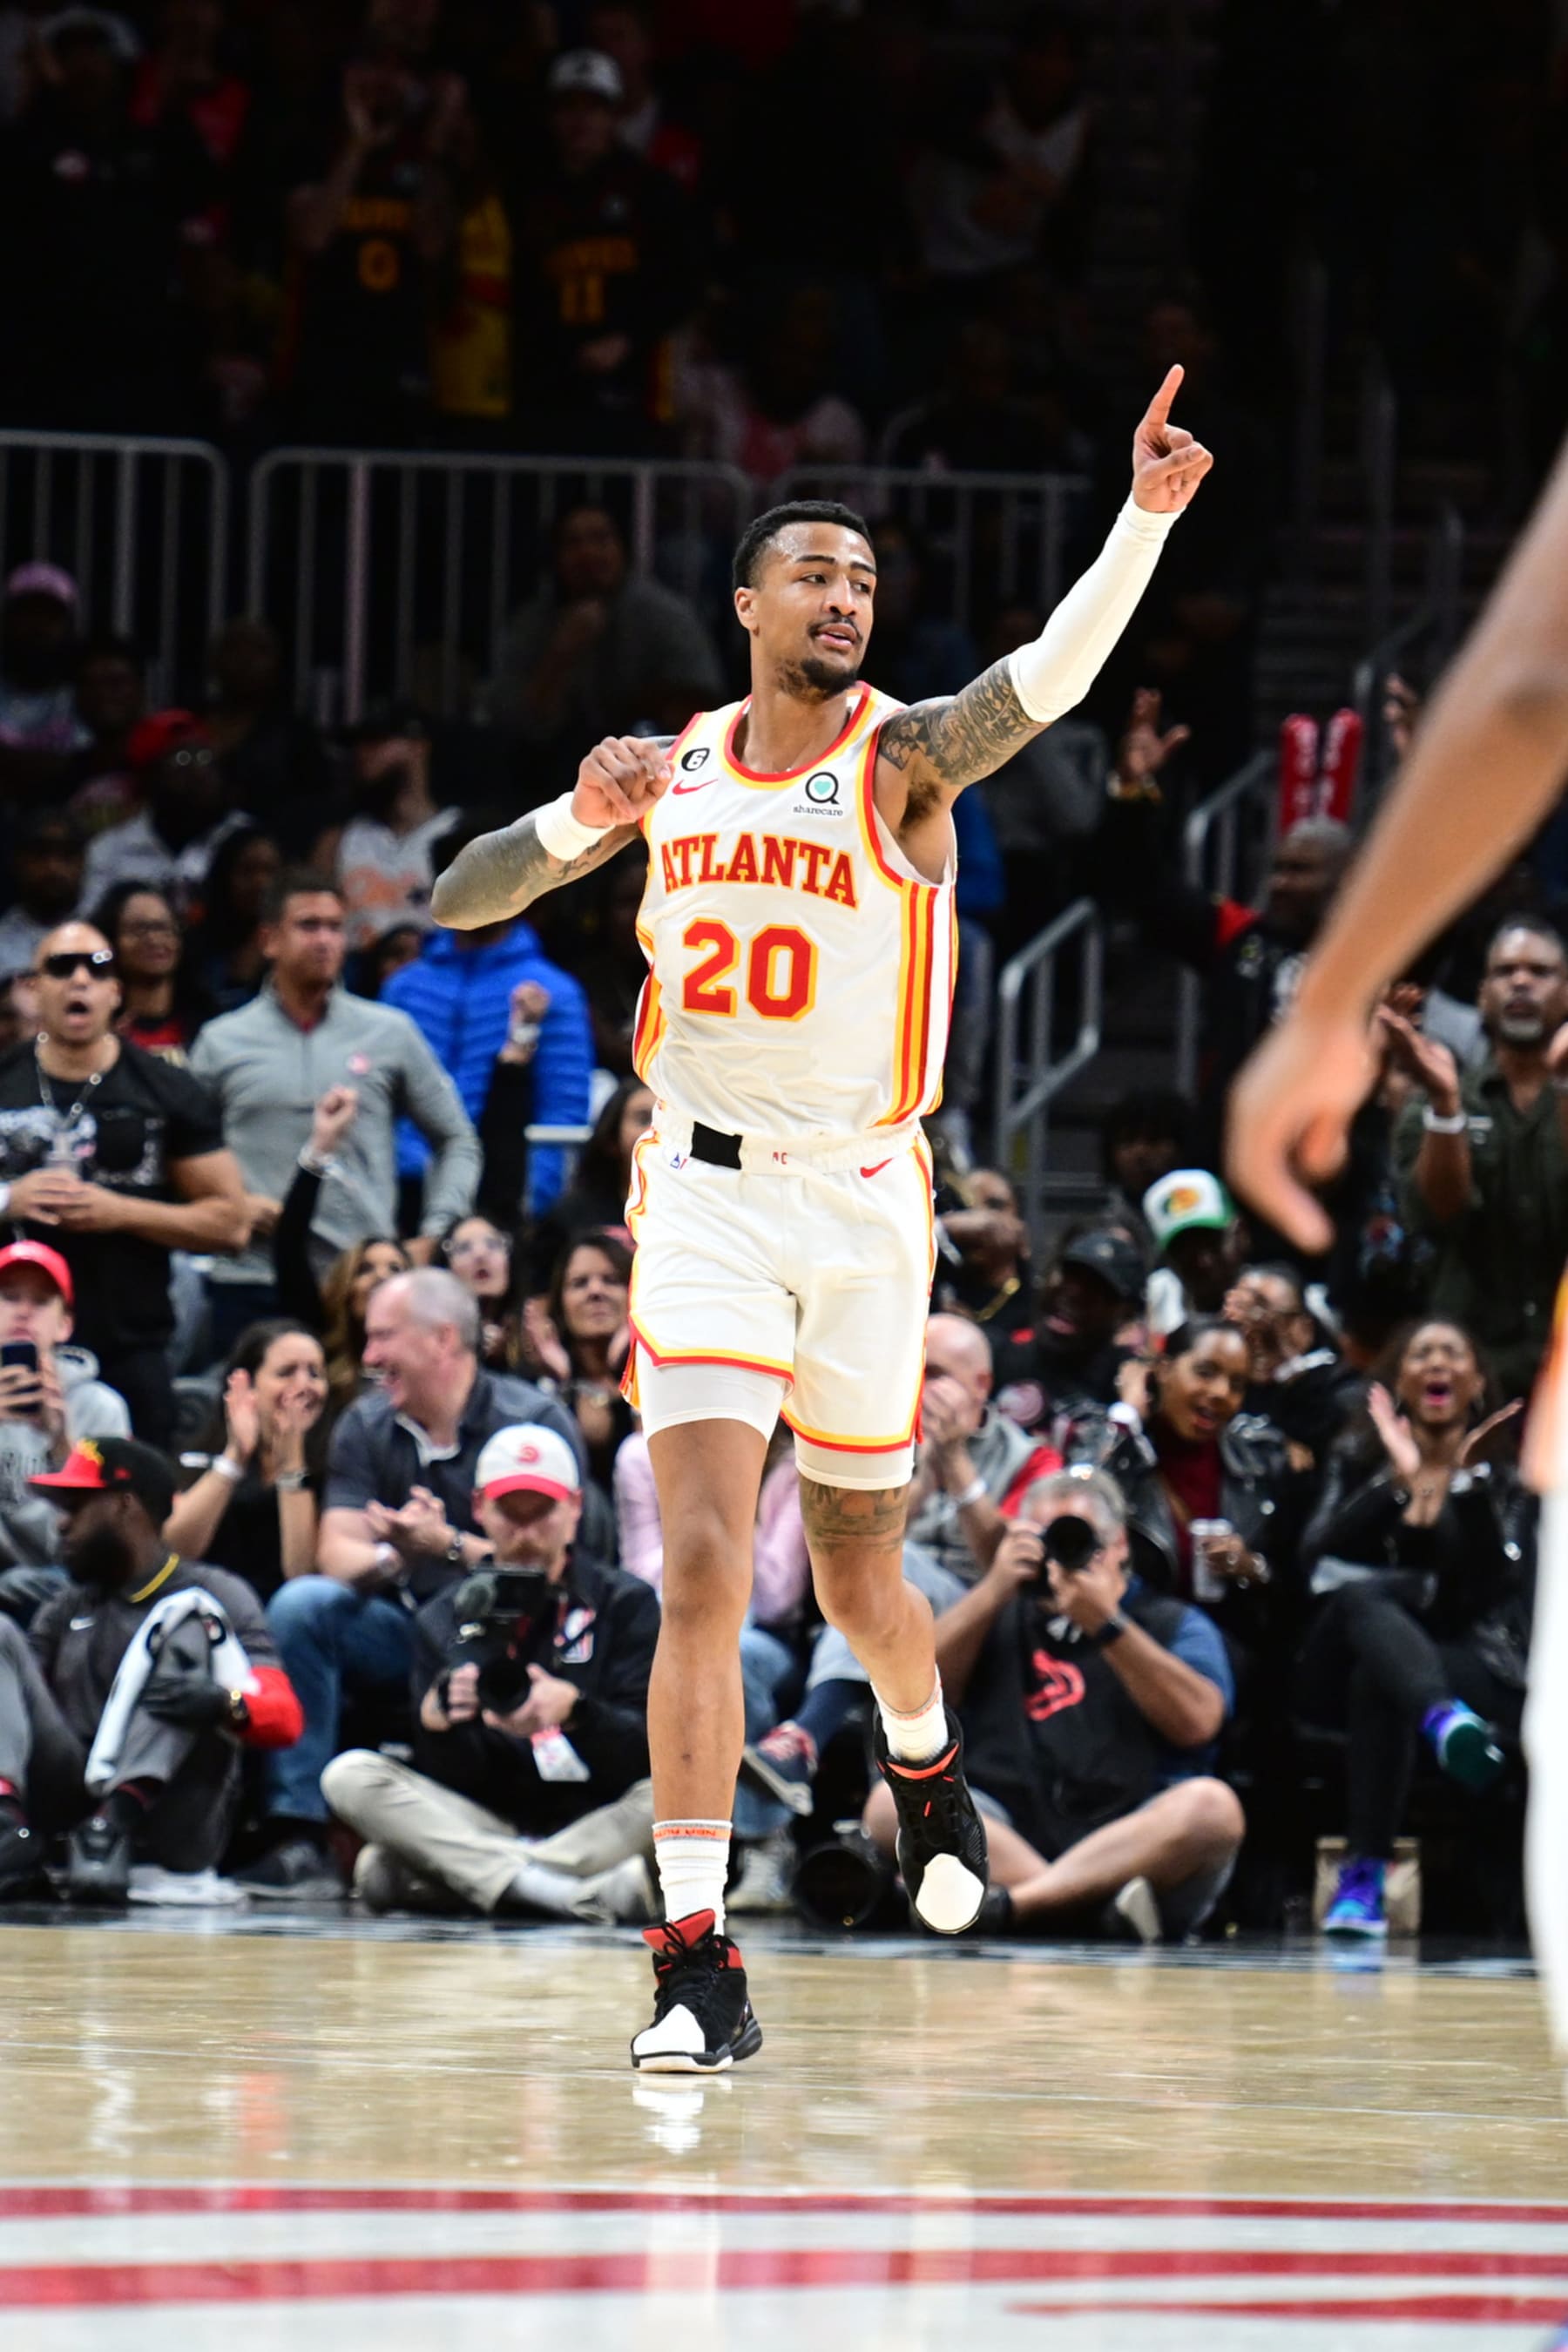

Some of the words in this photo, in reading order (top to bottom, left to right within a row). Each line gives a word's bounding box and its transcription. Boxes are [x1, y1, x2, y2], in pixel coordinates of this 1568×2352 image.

[680, 747, 710, 772] 6
[792, 804, 844, 817] sharecare
[660, 832, 859, 911] ATLANTA
[681, 916, 819, 1023] 20
